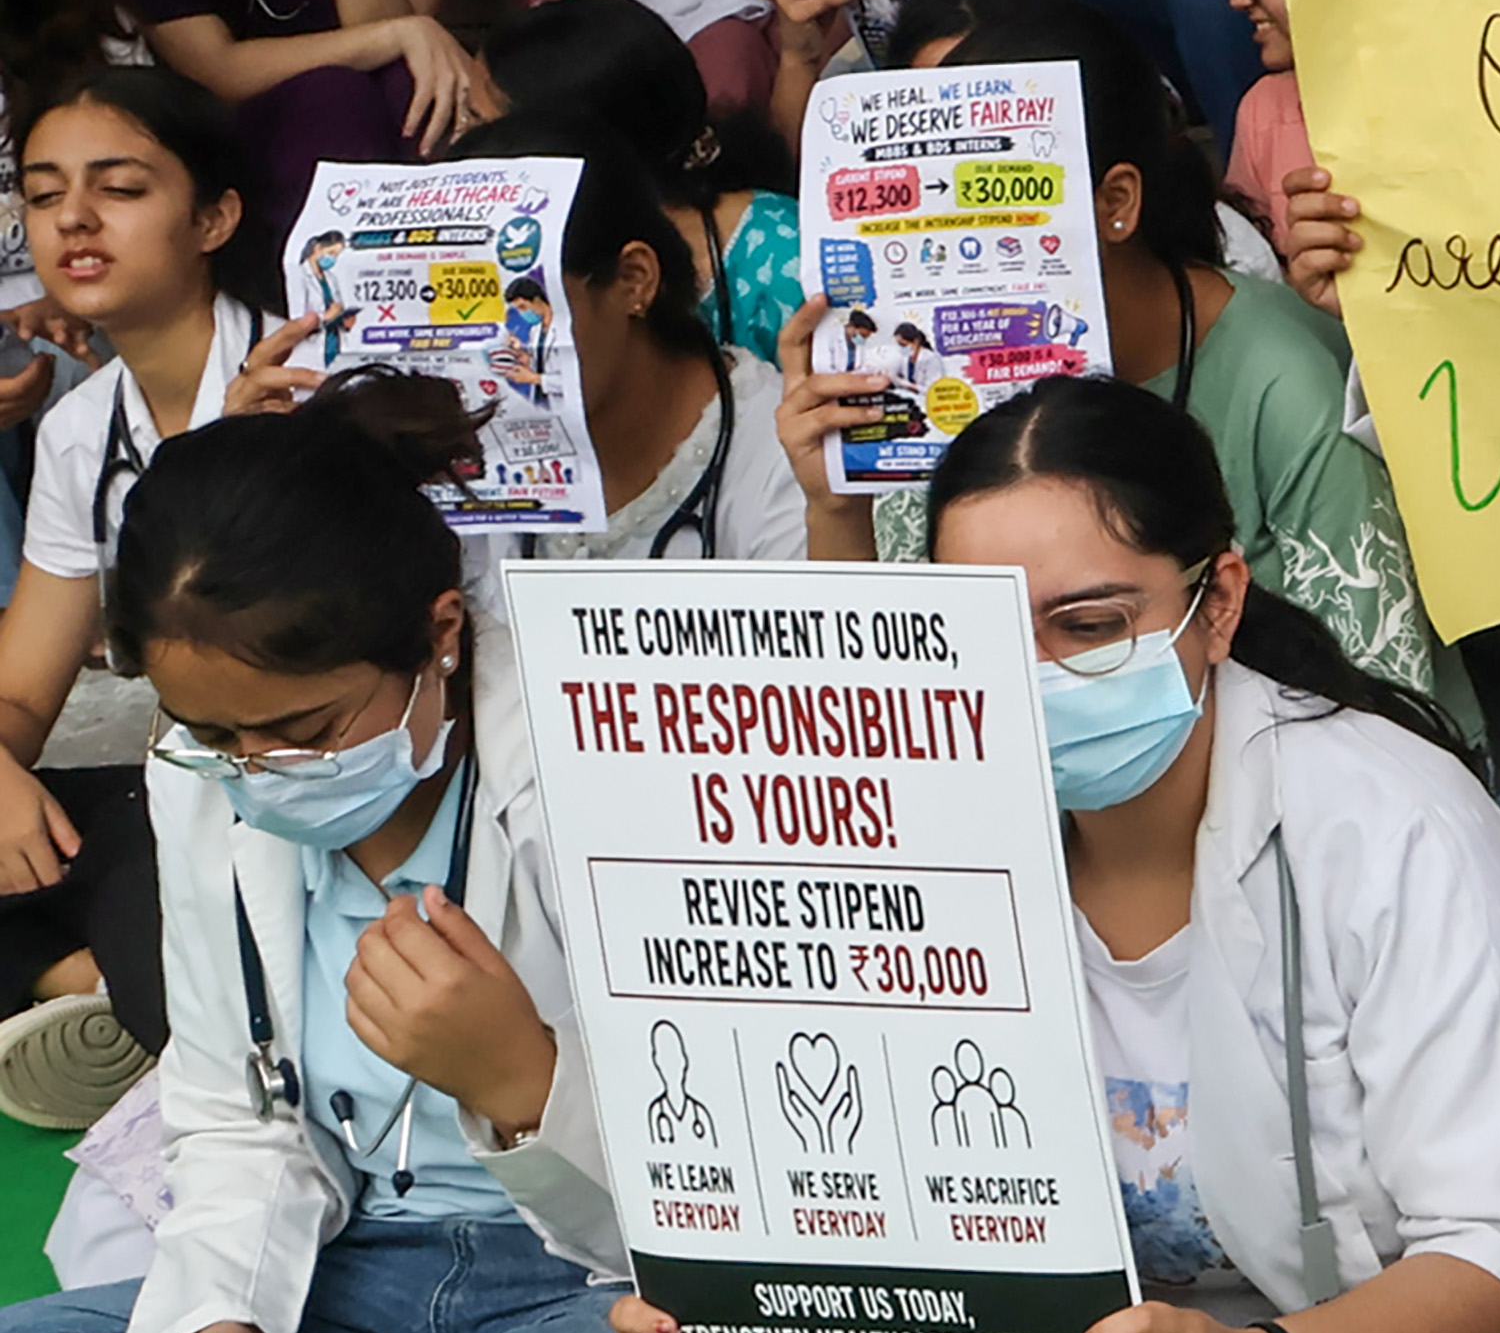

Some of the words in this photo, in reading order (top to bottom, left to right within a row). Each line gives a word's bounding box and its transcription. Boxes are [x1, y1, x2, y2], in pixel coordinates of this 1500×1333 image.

[851, 118, 886, 143] WE
[890, 108, 966, 140] DESERVE
[969, 100, 1015, 129] FAIR
[1016, 97, 1055, 127] PAY!
[408, 184, 521, 208] HEALTHCARE
[571, 607, 630, 657] THE
[635, 609, 832, 662] COMMITMENT
[836, 614, 861, 661] IS
[871, 614, 959, 670] OURS,
[561, 681, 641, 754] THE
[657, 683, 987, 763] RESPONSIBILITY
[691, 773, 733, 843] IS
[741, 774, 899, 849] YOURS!
[684, 877, 791, 931] REVISE
[799, 881, 925, 934] STIPEND
[643, 939, 793, 991] INCREASE
[798, 942, 839, 991] TO
[849, 944, 988, 1002] ₹30,000
[925, 1174, 960, 1205] WE
[962, 1175, 1060, 1208] SACRIFICE
[792, 1207, 887, 1241] EVERYDAY
[754, 1283, 856, 1319] SUPPORT
[859, 1286, 891, 1320] US
[894, 1288, 976, 1329] TODAY,
